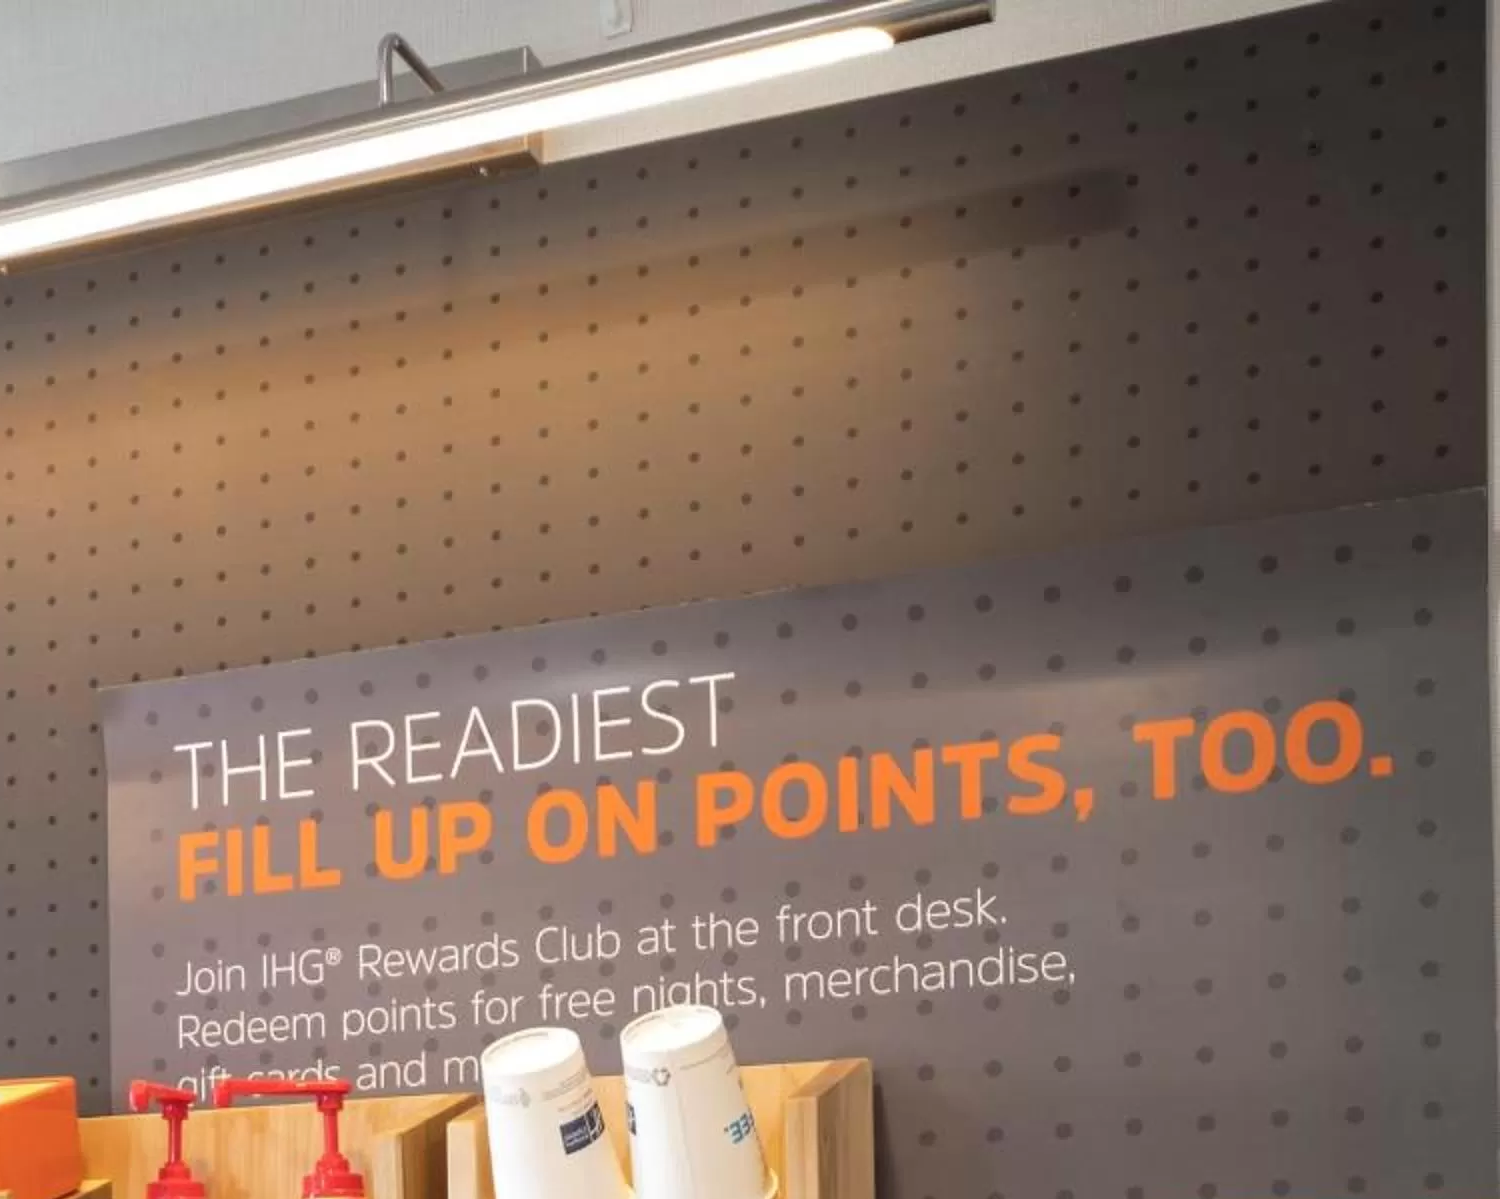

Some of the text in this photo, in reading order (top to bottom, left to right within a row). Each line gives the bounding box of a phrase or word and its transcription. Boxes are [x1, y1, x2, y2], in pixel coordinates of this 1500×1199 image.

[174, 671, 735, 811] THE READIEST
[178, 699, 1394, 900] FILL UP ON POINTS, TOO.
[176, 959, 246, 997] Join
[359, 932, 520, 980] Rewards
[535, 923, 621, 965] Club
[637, 917, 677, 956] at
[691, 911, 759, 949] the
[775, 899, 879, 944] front
[895, 888, 1008, 932] desk.
[177, 946, 1078, 1050] Redeem points for free nights, merchandise,
[355, 1050, 426, 1091] and
